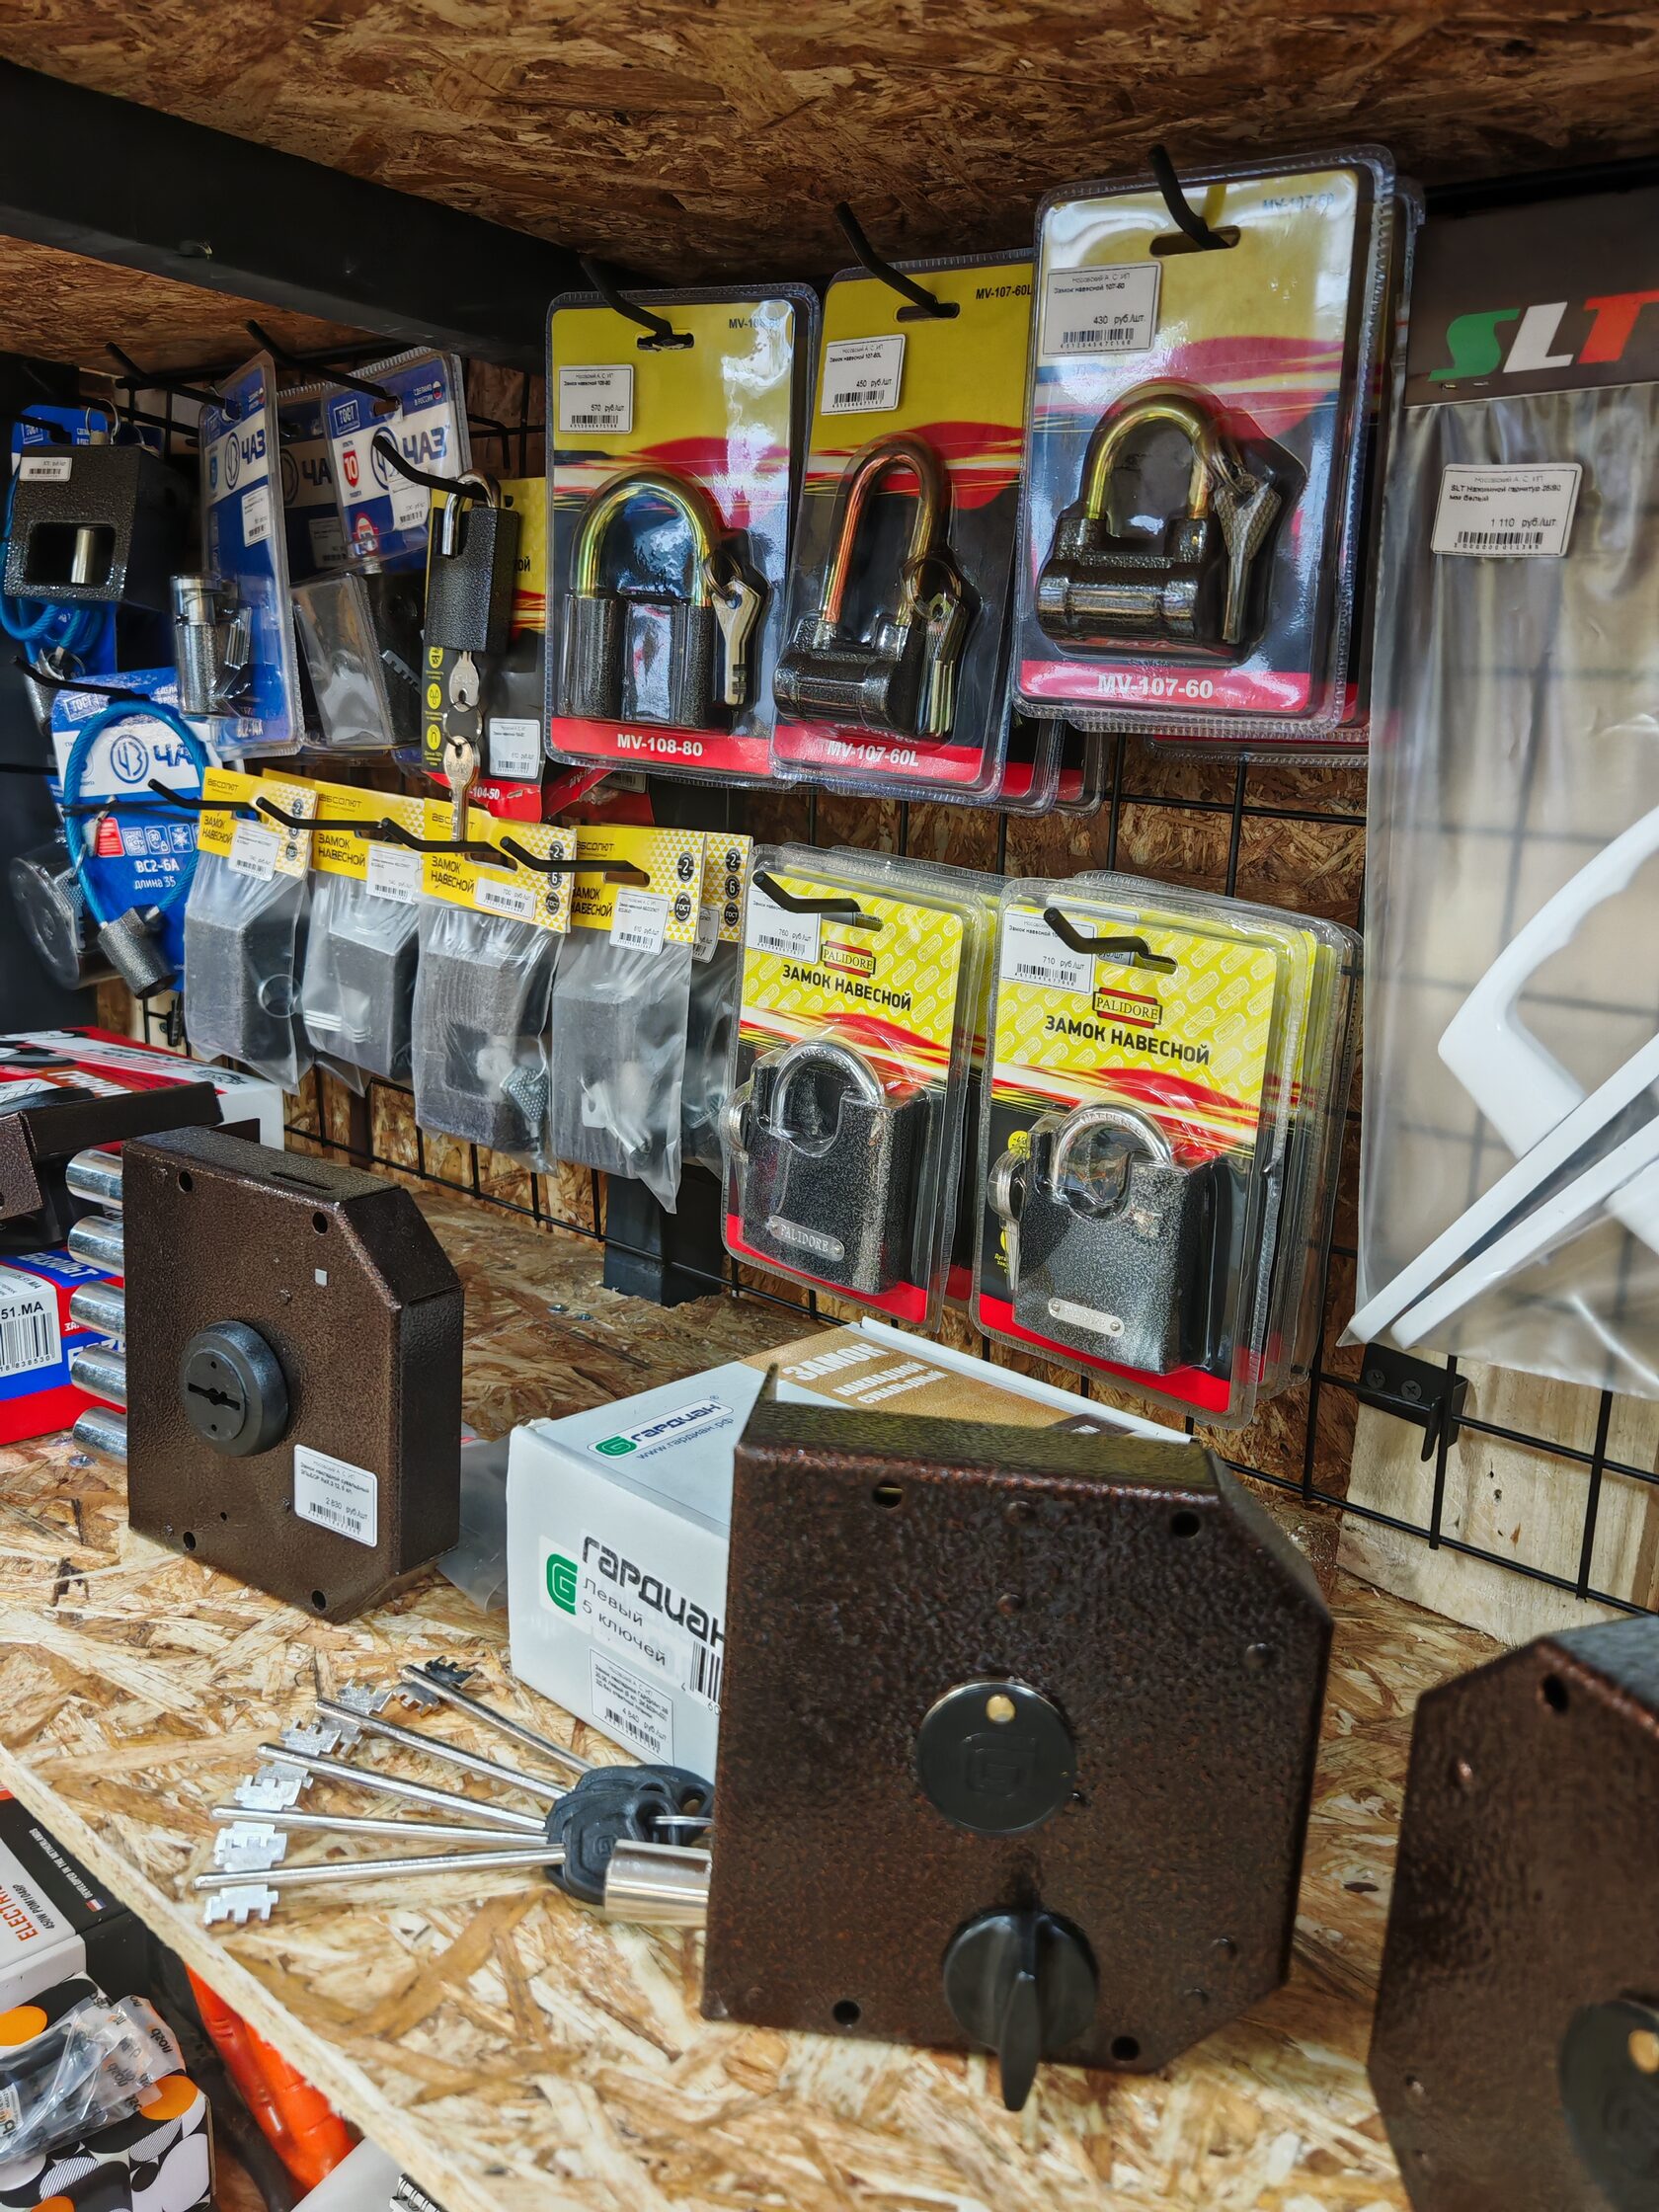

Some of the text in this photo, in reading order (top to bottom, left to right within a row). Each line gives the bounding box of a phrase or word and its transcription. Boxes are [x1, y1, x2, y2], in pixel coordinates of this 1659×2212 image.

[976, 284, 1033, 299] MV-107-60L
[1093, 315, 1108, 324] 430
[1428, 289, 1659, 381] SLT
[241, 429, 267, 465] ЧАЗ
[402, 427, 447, 464] ЧАЗ
[302, 457, 333, 486] ЧА
[345, 454, 357, 480] 10
[1500, 518, 1515, 527] 110
[1098, 673, 1214, 699] MV-107-60
[153, 744, 195, 767] ЧА
[617, 734, 703, 756] MV-108-80
[828, 741, 919, 767] MV-107-60L
[204, 816, 226, 829] ЗАМОК
[202, 829, 233, 845] НАВЕСНОЙ
[318, 832, 351, 849] ЗАМОК
[318, 846, 365, 867] НАВЕСНОЙ
[432, 855, 461, 874] ЗАМОК
[165, 876, 176, 887] 35
[431, 870, 475, 894] НАВЕСНОЙ
[675, 904, 690, 912] ГОСТ
[824, 948, 873, 971] PALIDORE
[1043, 955, 1056, 965] 710
[782, 965, 912, 1011] ЗАМОК НАВЕСНОЙ
[1096, 996, 1159, 1020] PALIDORE
[1045, 1015, 1211, 1066] ЗАМОК НАВЕСНОЙ
[780, 1224, 829, 1252] PALIDORE
[781, 1342, 890, 1381] ЗАМОК
[831, 1361, 929, 1397] НАКЛАДНОЙ
[583, 1577, 644, 1627] Левый
[582, 1600, 667, 1667] 5 ключей
[29, 1828, 60, 1859] NETHERLANDS
[65, 1871, 94, 1899] DEVELOPED
[0, 1882, 39, 1941] ELECTRI
